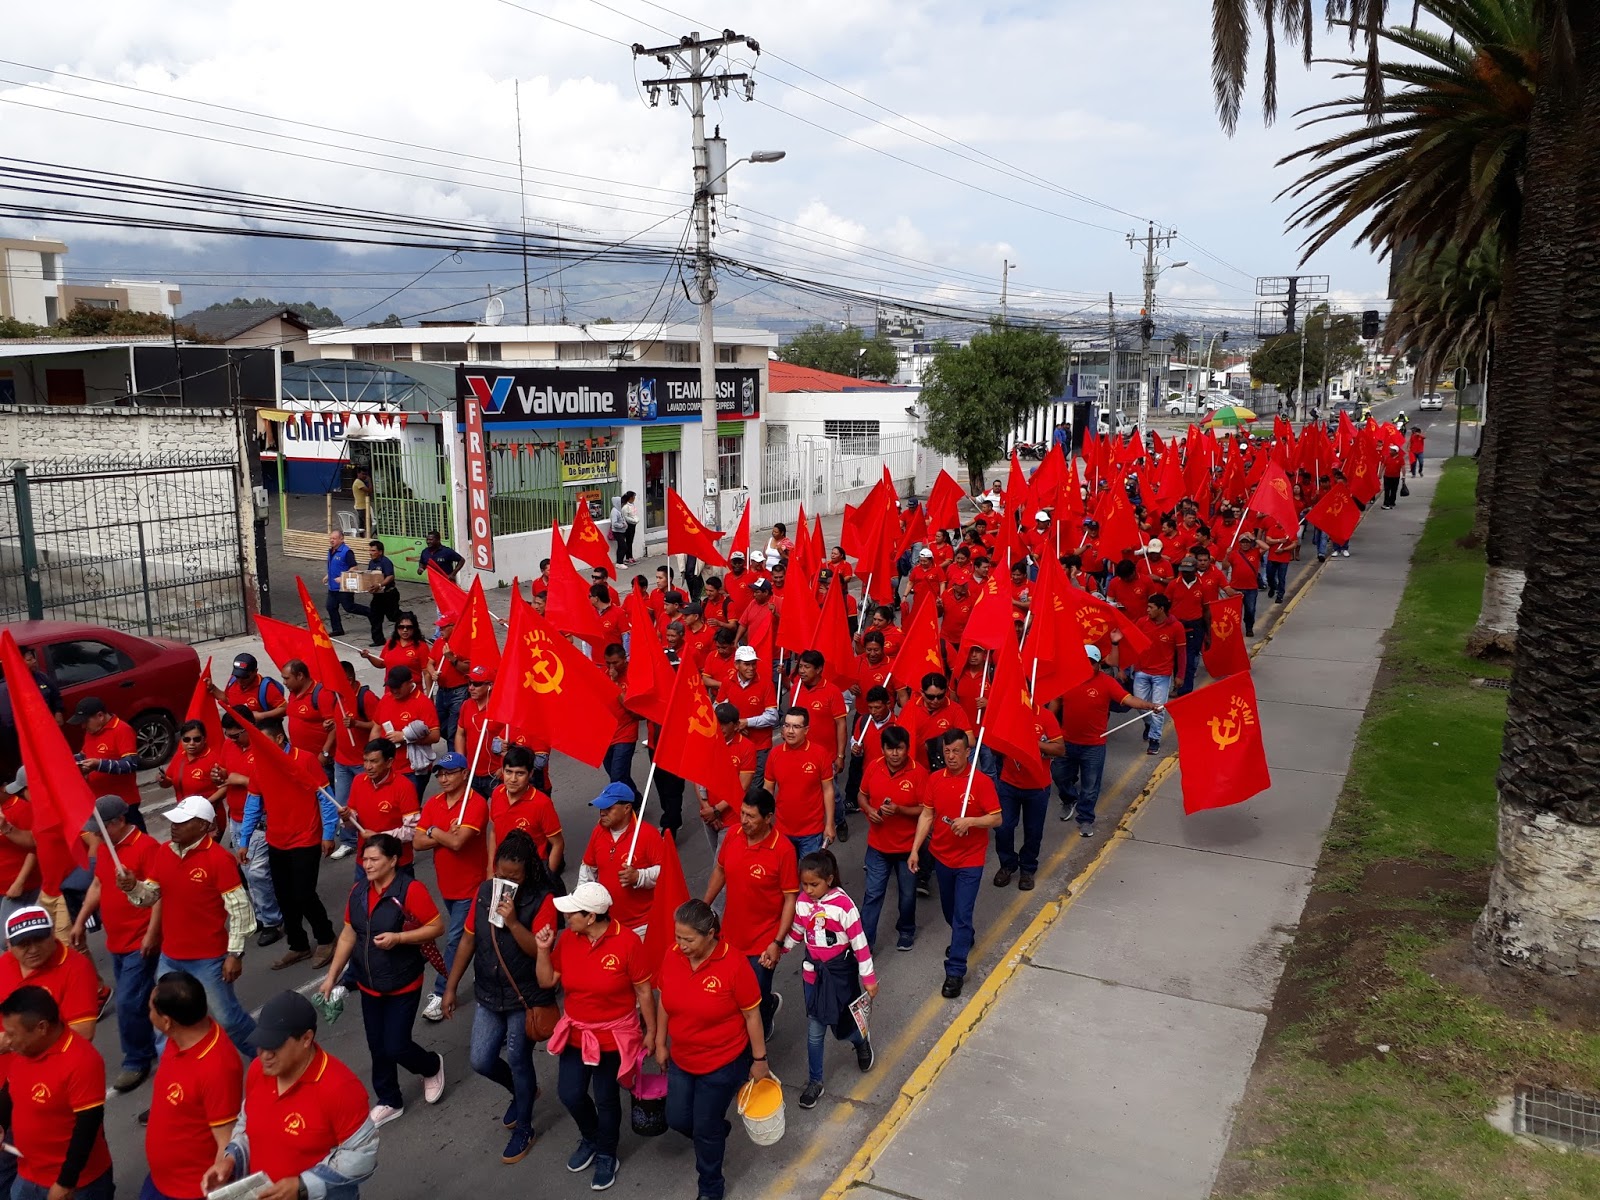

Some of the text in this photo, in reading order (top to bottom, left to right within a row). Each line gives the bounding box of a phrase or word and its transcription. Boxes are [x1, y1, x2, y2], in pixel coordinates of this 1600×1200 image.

[667, 382, 735, 399] TEAM ASH
[517, 386, 614, 414] Valvoline
[667, 403, 686, 412] LAVADO
[716, 401, 735, 410] EXPRESS
[563, 450, 615, 466] ARQUEADERO
[568, 467, 577, 475] De
[468, 403, 489, 566] FRENOS
[1230, 695, 1255, 725] SUTMI
[10, 918, 46, 932] HILFIGER
